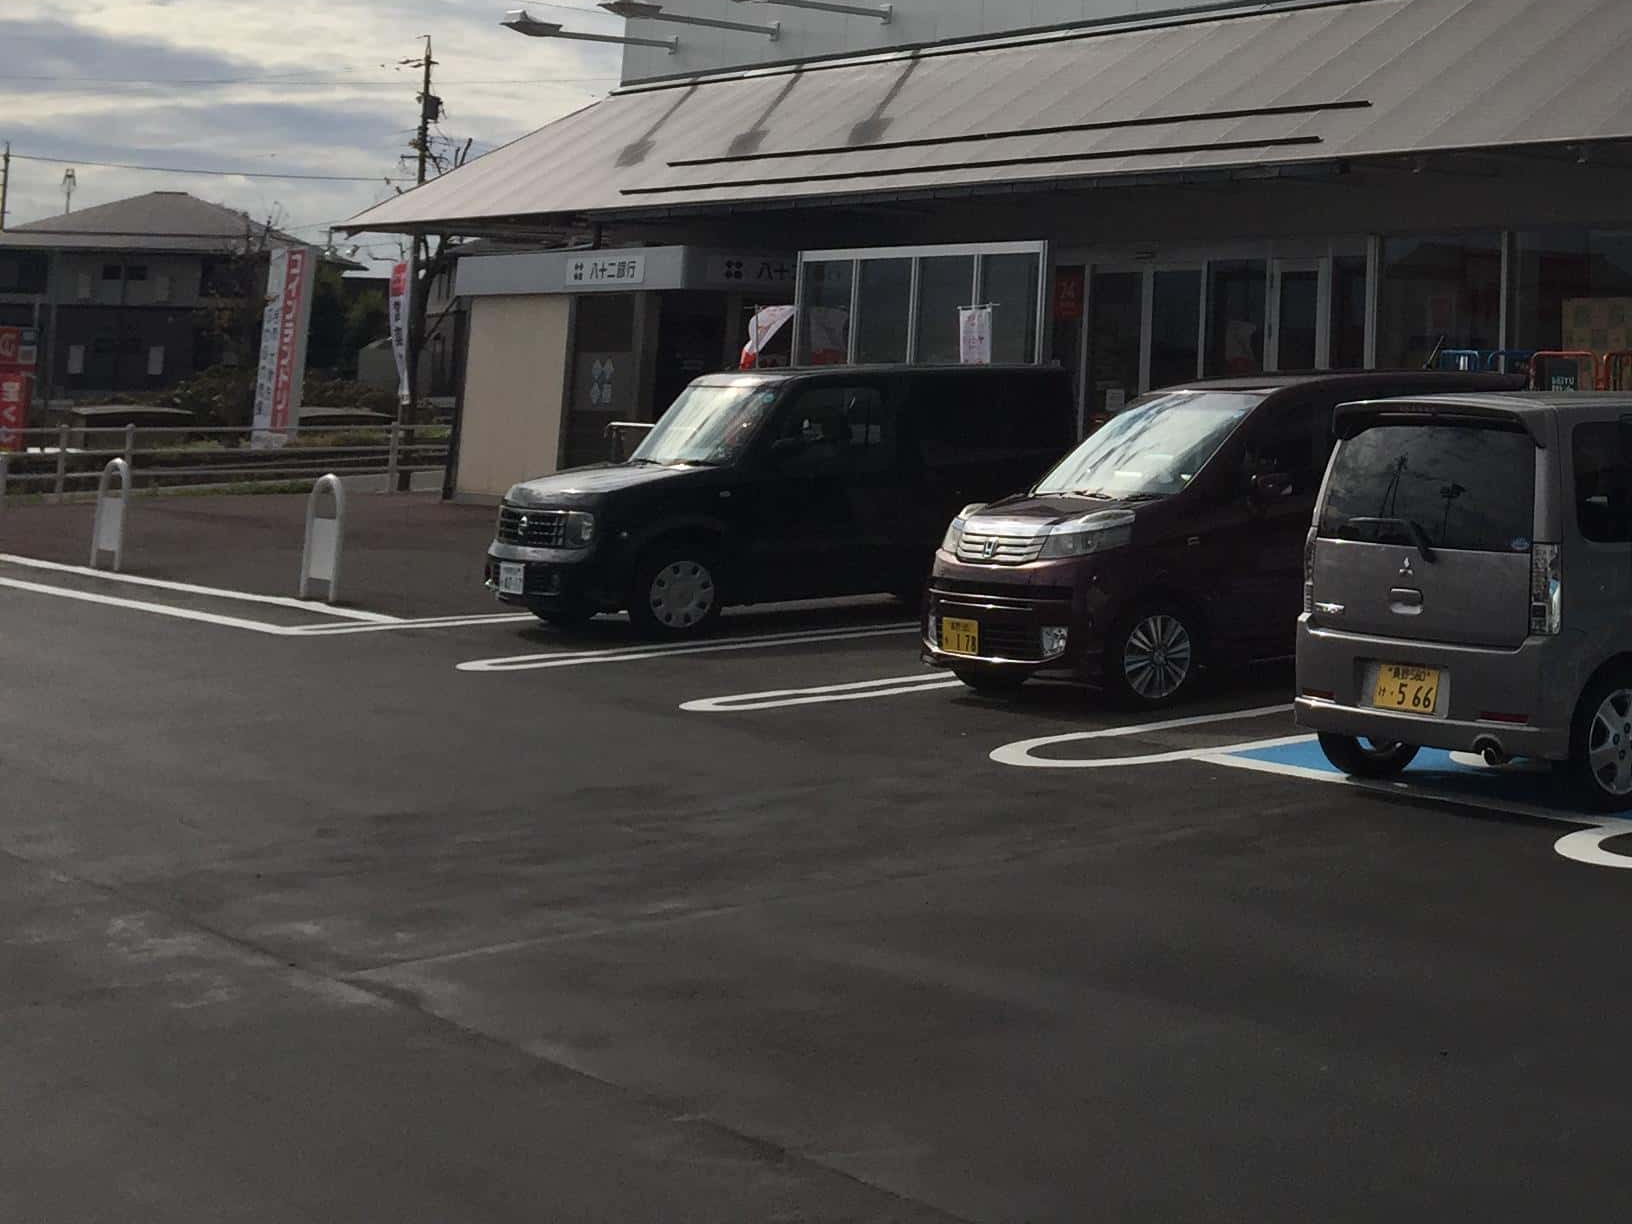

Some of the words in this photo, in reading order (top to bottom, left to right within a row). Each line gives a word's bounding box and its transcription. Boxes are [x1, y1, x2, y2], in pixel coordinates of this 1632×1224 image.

[589, 260, 637, 281] 八十二銀行
